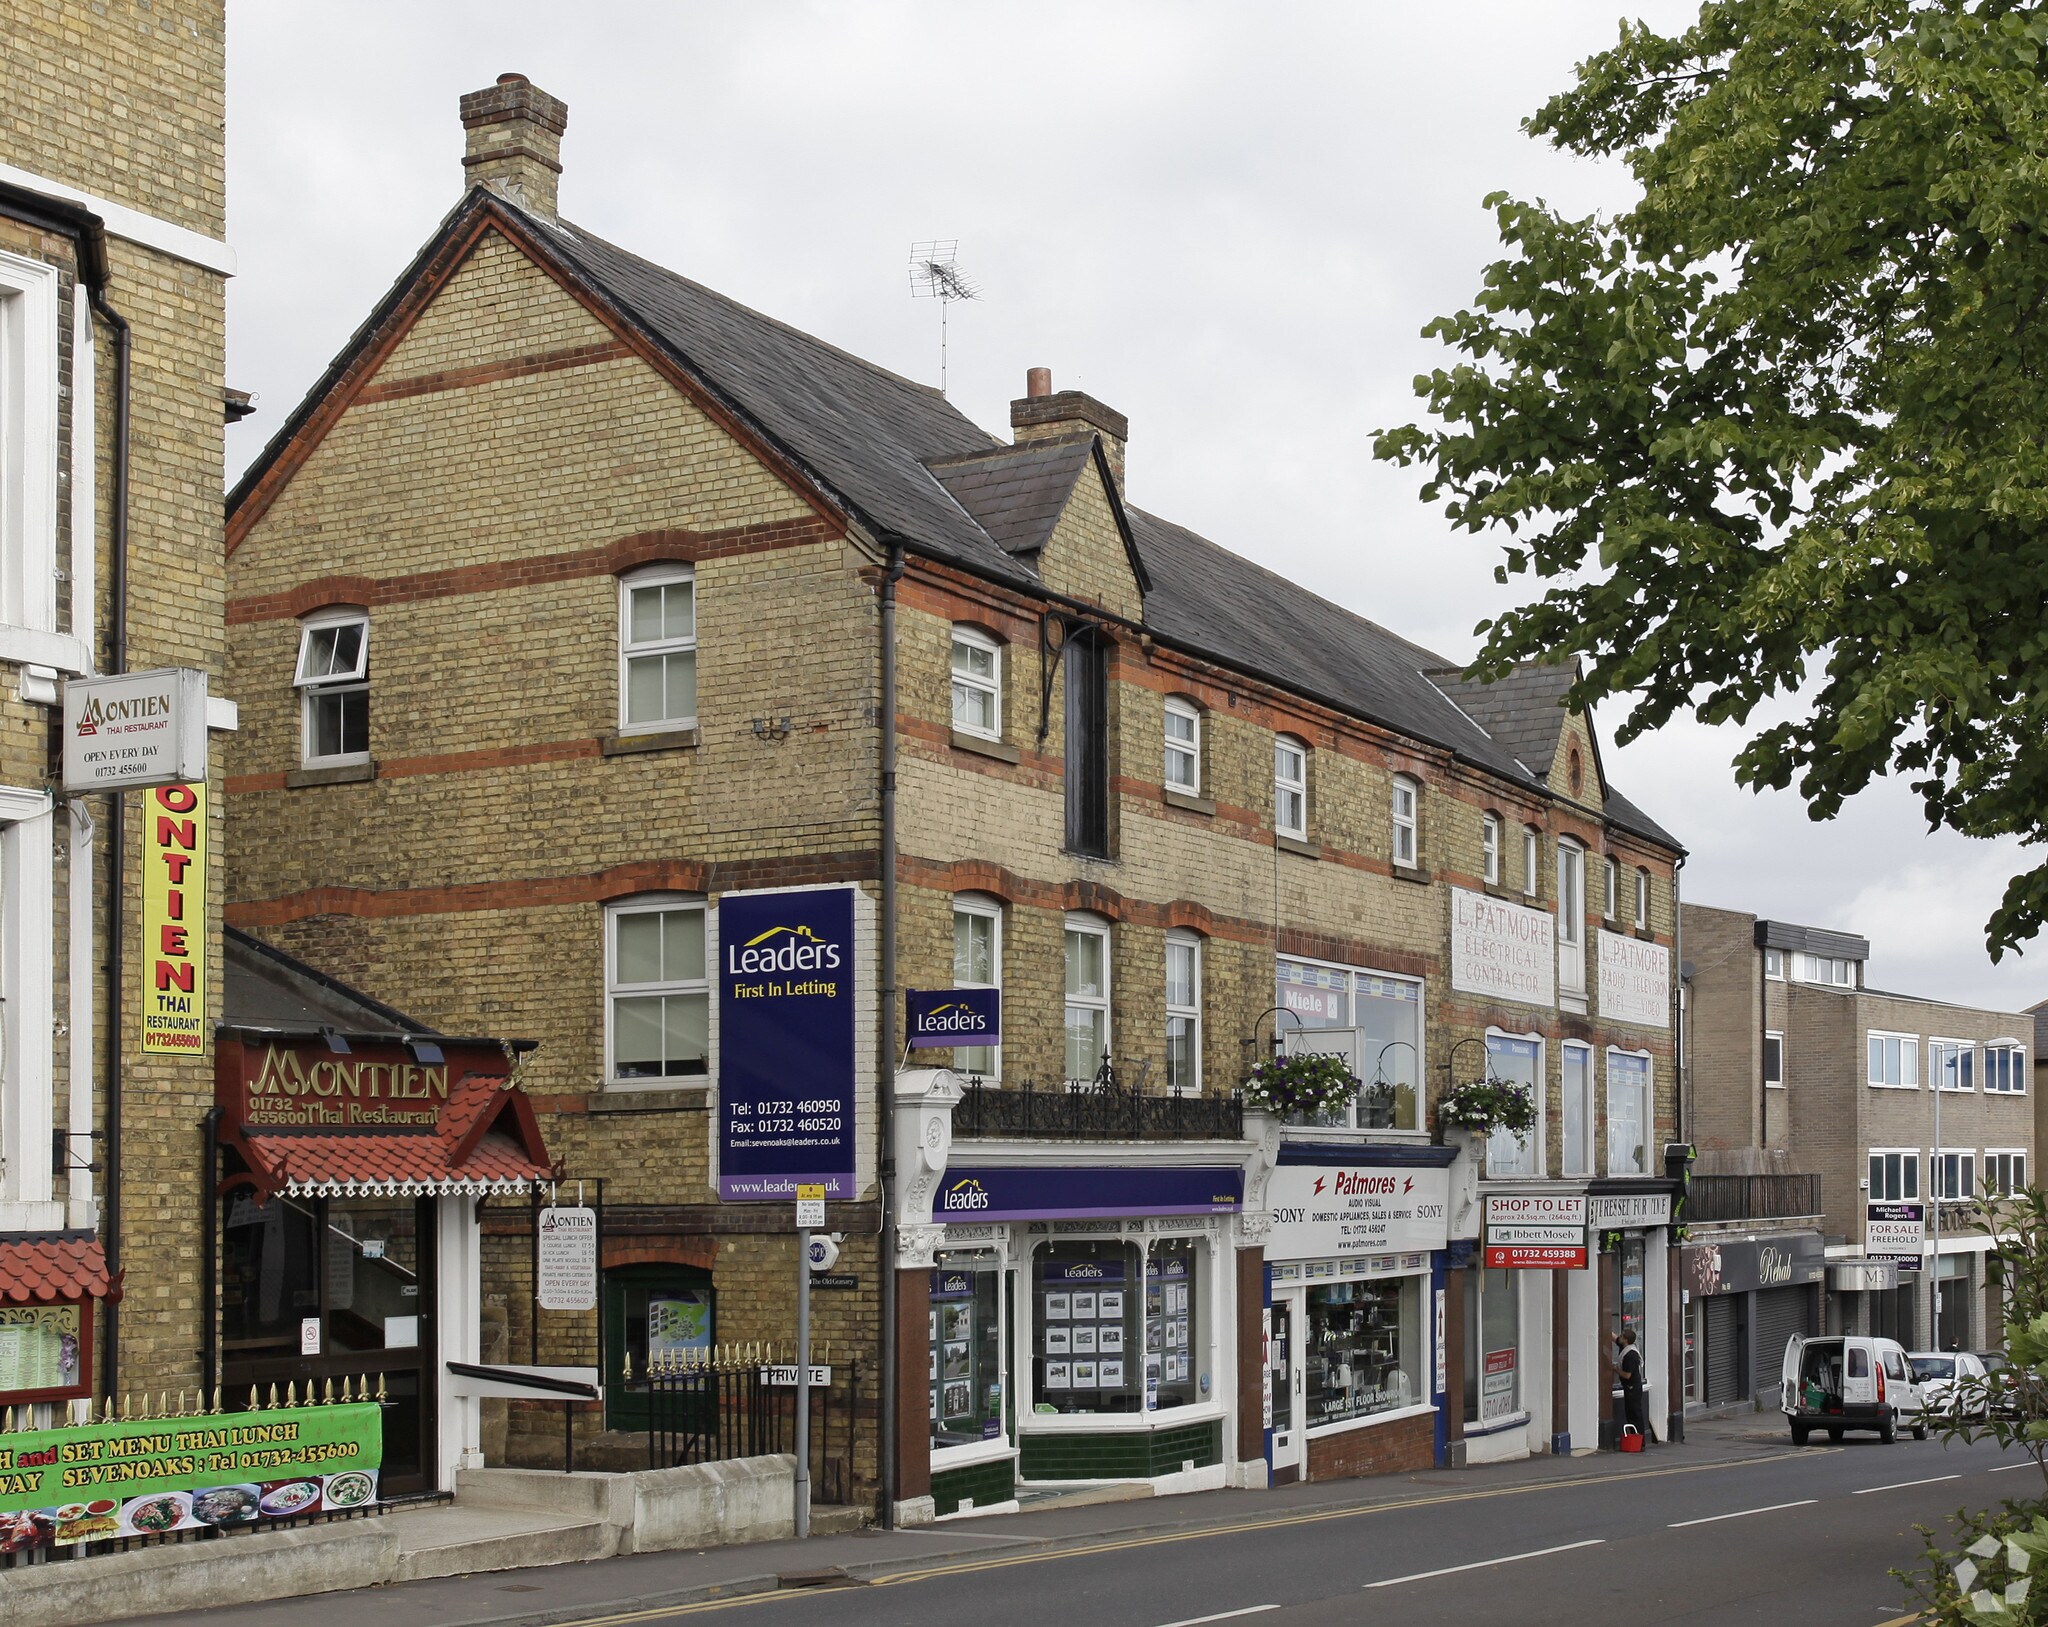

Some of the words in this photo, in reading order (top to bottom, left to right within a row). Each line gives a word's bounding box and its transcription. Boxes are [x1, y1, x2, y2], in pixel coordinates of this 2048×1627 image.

[76, 690, 170, 729] MONTIEN
[107, 726, 122, 735] THAI
[124, 720, 168, 733] RESTAURANT
[84, 751, 107, 763] OPEN
[109, 747, 140, 760] EVERY
[142, 745, 159, 757] DAY
[95, 766, 116, 778] 01732
[119, 763, 147, 775] 455600
[729, 937, 841, 975] Leaders
[1465, 936, 1540, 969] ELECTRICAL
[1465, 962, 1539, 993] CONTRACTOR
[1601, 969, 1626, 989] RADIO
[1633, 975, 1667, 997] TELEVISION
[734, 983, 764, 998] First
[768, 982, 782, 996] In
[786, 979, 837, 998] Letting
[157, 995, 191, 1013] THAI
[1285, 990, 1322, 1012] Miele
[1641, 998, 1660, 1017] VIDEO
[147, 1015, 200, 1030] RESTAURANT
[918, 1010, 986, 1032] Leaders
[146, 1032, 201, 1048] 01732455600
[248, 1040, 448, 1098] MONTIEN
[249, 1097, 293, 1111] 01732
[730, 1102, 752, 1115] Tel:
[758, 1101, 793, 1115] 01732
[797, 1099, 841, 1113] 460950
[248, 1111, 306, 1124] 455600
[301, 1102, 344, 1124] Thai
[349, 1103, 441, 1124] Restaurant
[730, 1121, 755, 1133] Fax:
[758, 1119, 794, 1132] 01732
[798, 1118, 841, 1131] 460520
[731, 1178, 840, 1193] www.leaderuk
[1334, 1171, 1396, 1196] Patmores
[944, 1185, 989, 1210] Leaders
[1348, 1198, 1363, 1208] AUDIO
[1364, 1198, 1381, 1207] VISUAL
[1491, 1199, 1530, 1211] SHOP
[1534, 1199, 1553, 1211] TO
[1558, 1199, 1582, 1211] LET
[1273, 1208, 1306, 1223] SONY
[1312, 1213, 1338, 1222] DOMESTIC
[1340, 1211, 1371, 1222] APPLIANCES,
[1372, 1210, 1387, 1220] SALES
[1393, 1210, 1412, 1219] SERVICE
[1417, 1205, 1443, 1219] SONY
[542, 1212, 593, 1229] MONTIEN
[1341, 1225, 1352, 1235] TEL:
[1353, 1225, 1367, 1235] 01732
[1514, 1230, 1541, 1239] Ibbett
[1543, 1230, 1576, 1240] Mosely
[1870, 1225, 1891, 1234] FOR
[1893, 1225, 1919, 1234] SALE
[1337, 1238, 1387, 1249] www.patmores.com
[1512, 1249, 1540, 1258] 01732
[1542, 1249, 1576, 1258] 459388
[1064, 1267, 1103, 1278] Leaders
[1167, 1265, 1184, 1275] Leaders
[1760, 1246, 1792, 1284] Rehab
[545, 1279, 560, 1287] OPEN
[561, 1279, 579, 1287] EVERY
[580, 1279, 591, 1287] DAY
[1865, 1270, 1885, 1283] M3
[944, 1280, 967, 1291] Leaders
[768, 1369, 823, 1382] PRIVTE
[1324, 1400, 1343, 1413] LARGE
[1356, 1393, 1375, 1406] FLOOR
[17, 1444, 58, 1468] and
[61, 1440, 104, 1464] SET
[108, 1433, 172, 1459] MENU
[175, 1427, 227, 1450] THAI
[231, 1422, 300, 1446] LUNCH
[62, 1454, 195, 1488] SEVENOAKS
[208, 1451, 237, 1472] Tel
[240, 1441, 359, 1469] 01732-455600
